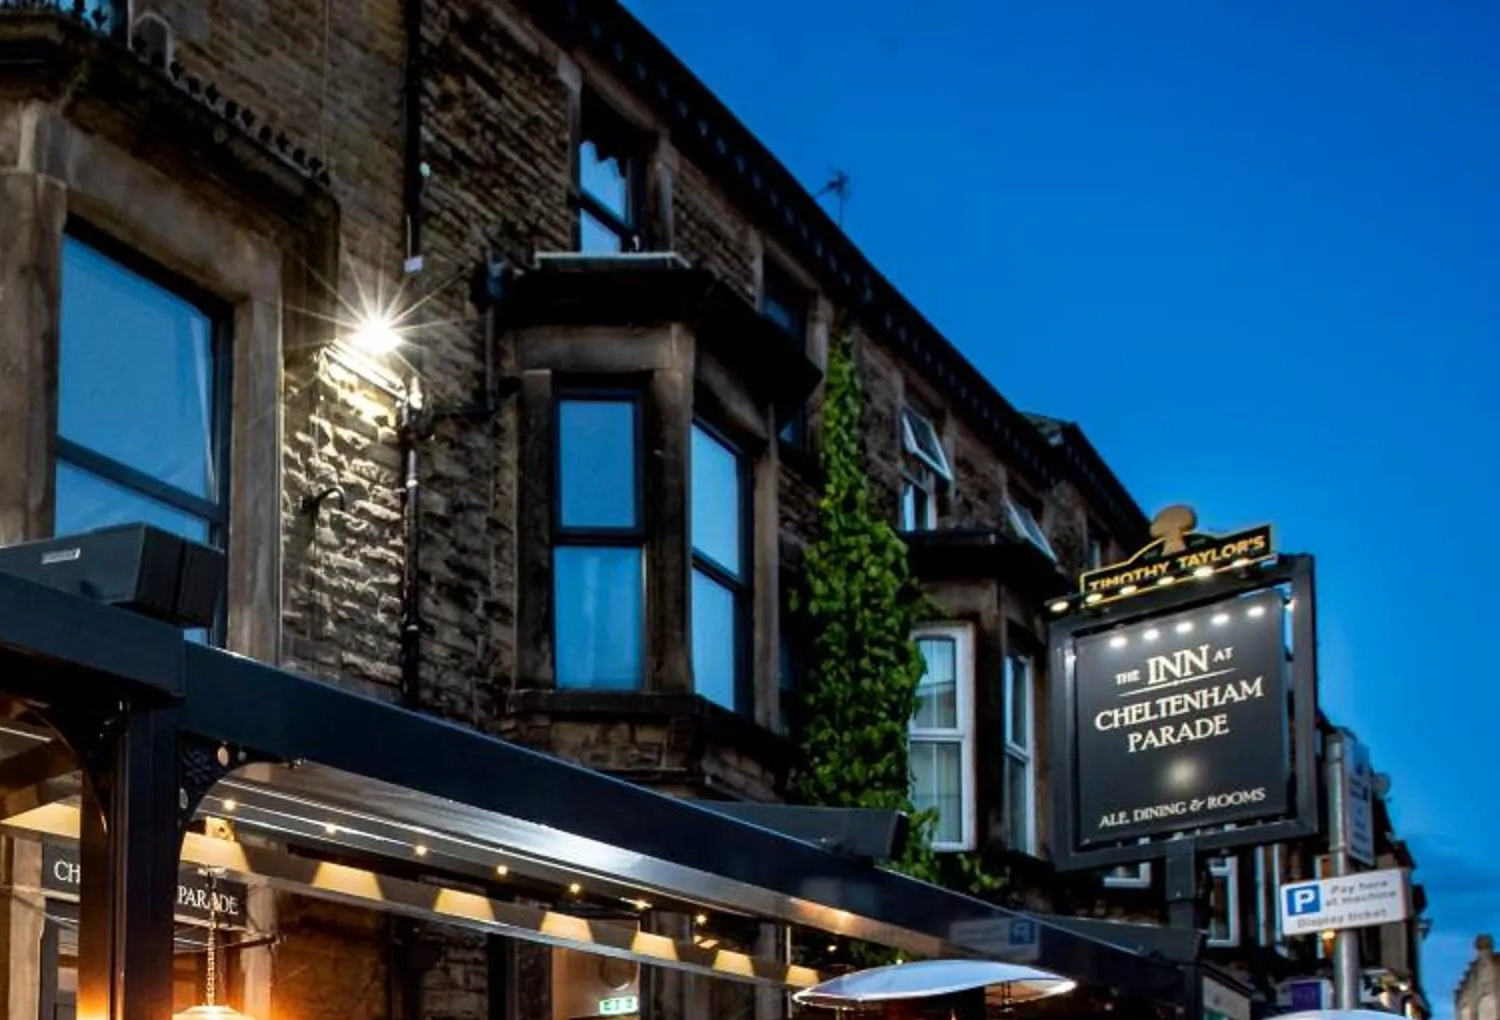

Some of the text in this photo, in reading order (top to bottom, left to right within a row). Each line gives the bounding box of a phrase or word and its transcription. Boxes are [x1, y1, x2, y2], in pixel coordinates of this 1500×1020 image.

[1089, 535, 1265, 592] TIMOTHY TAYLOR'S
[1115, 645, 1233, 686] THE INN AT
[1094, 677, 1264, 732] CHELTENHAM
[1127, 714, 1230, 753] PARADE
[1134, 801, 1187, 822] DINING
[1189, 799, 1205, 812] &
[1207, 788, 1266, 810] ROOMS
[177, 885, 239, 915] PARADE
[1294, 889, 1315, 913] P
